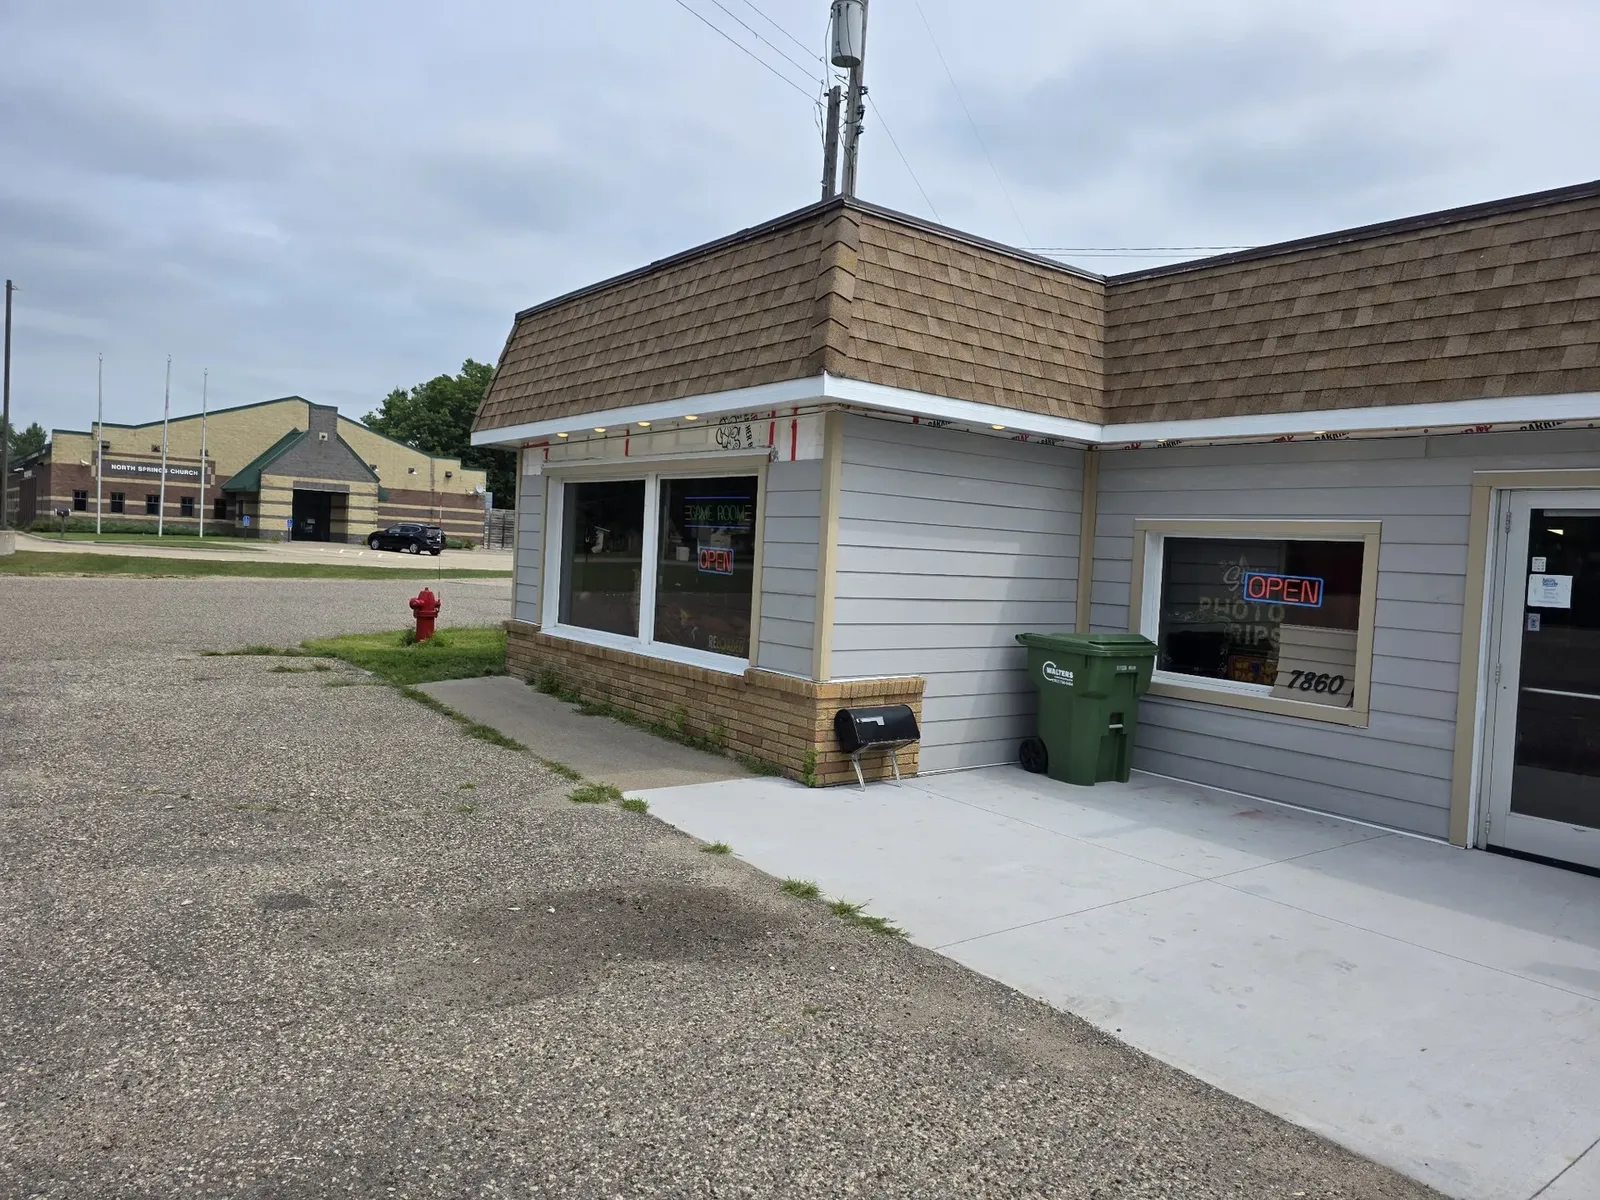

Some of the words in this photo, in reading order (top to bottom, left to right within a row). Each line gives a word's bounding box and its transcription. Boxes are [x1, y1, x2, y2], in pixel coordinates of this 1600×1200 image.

[690, 504, 714, 521] GAME
[717, 504, 745, 521] ROOM
[700, 549, 732, 571] OPEN
[1248, 575, 1319, 604] OPEN
[1199, 597, 1285, 622] PHOTO
[1046, 666, 1074, 679] WALTERS
[1288, 670, 1344, 694] 7860
